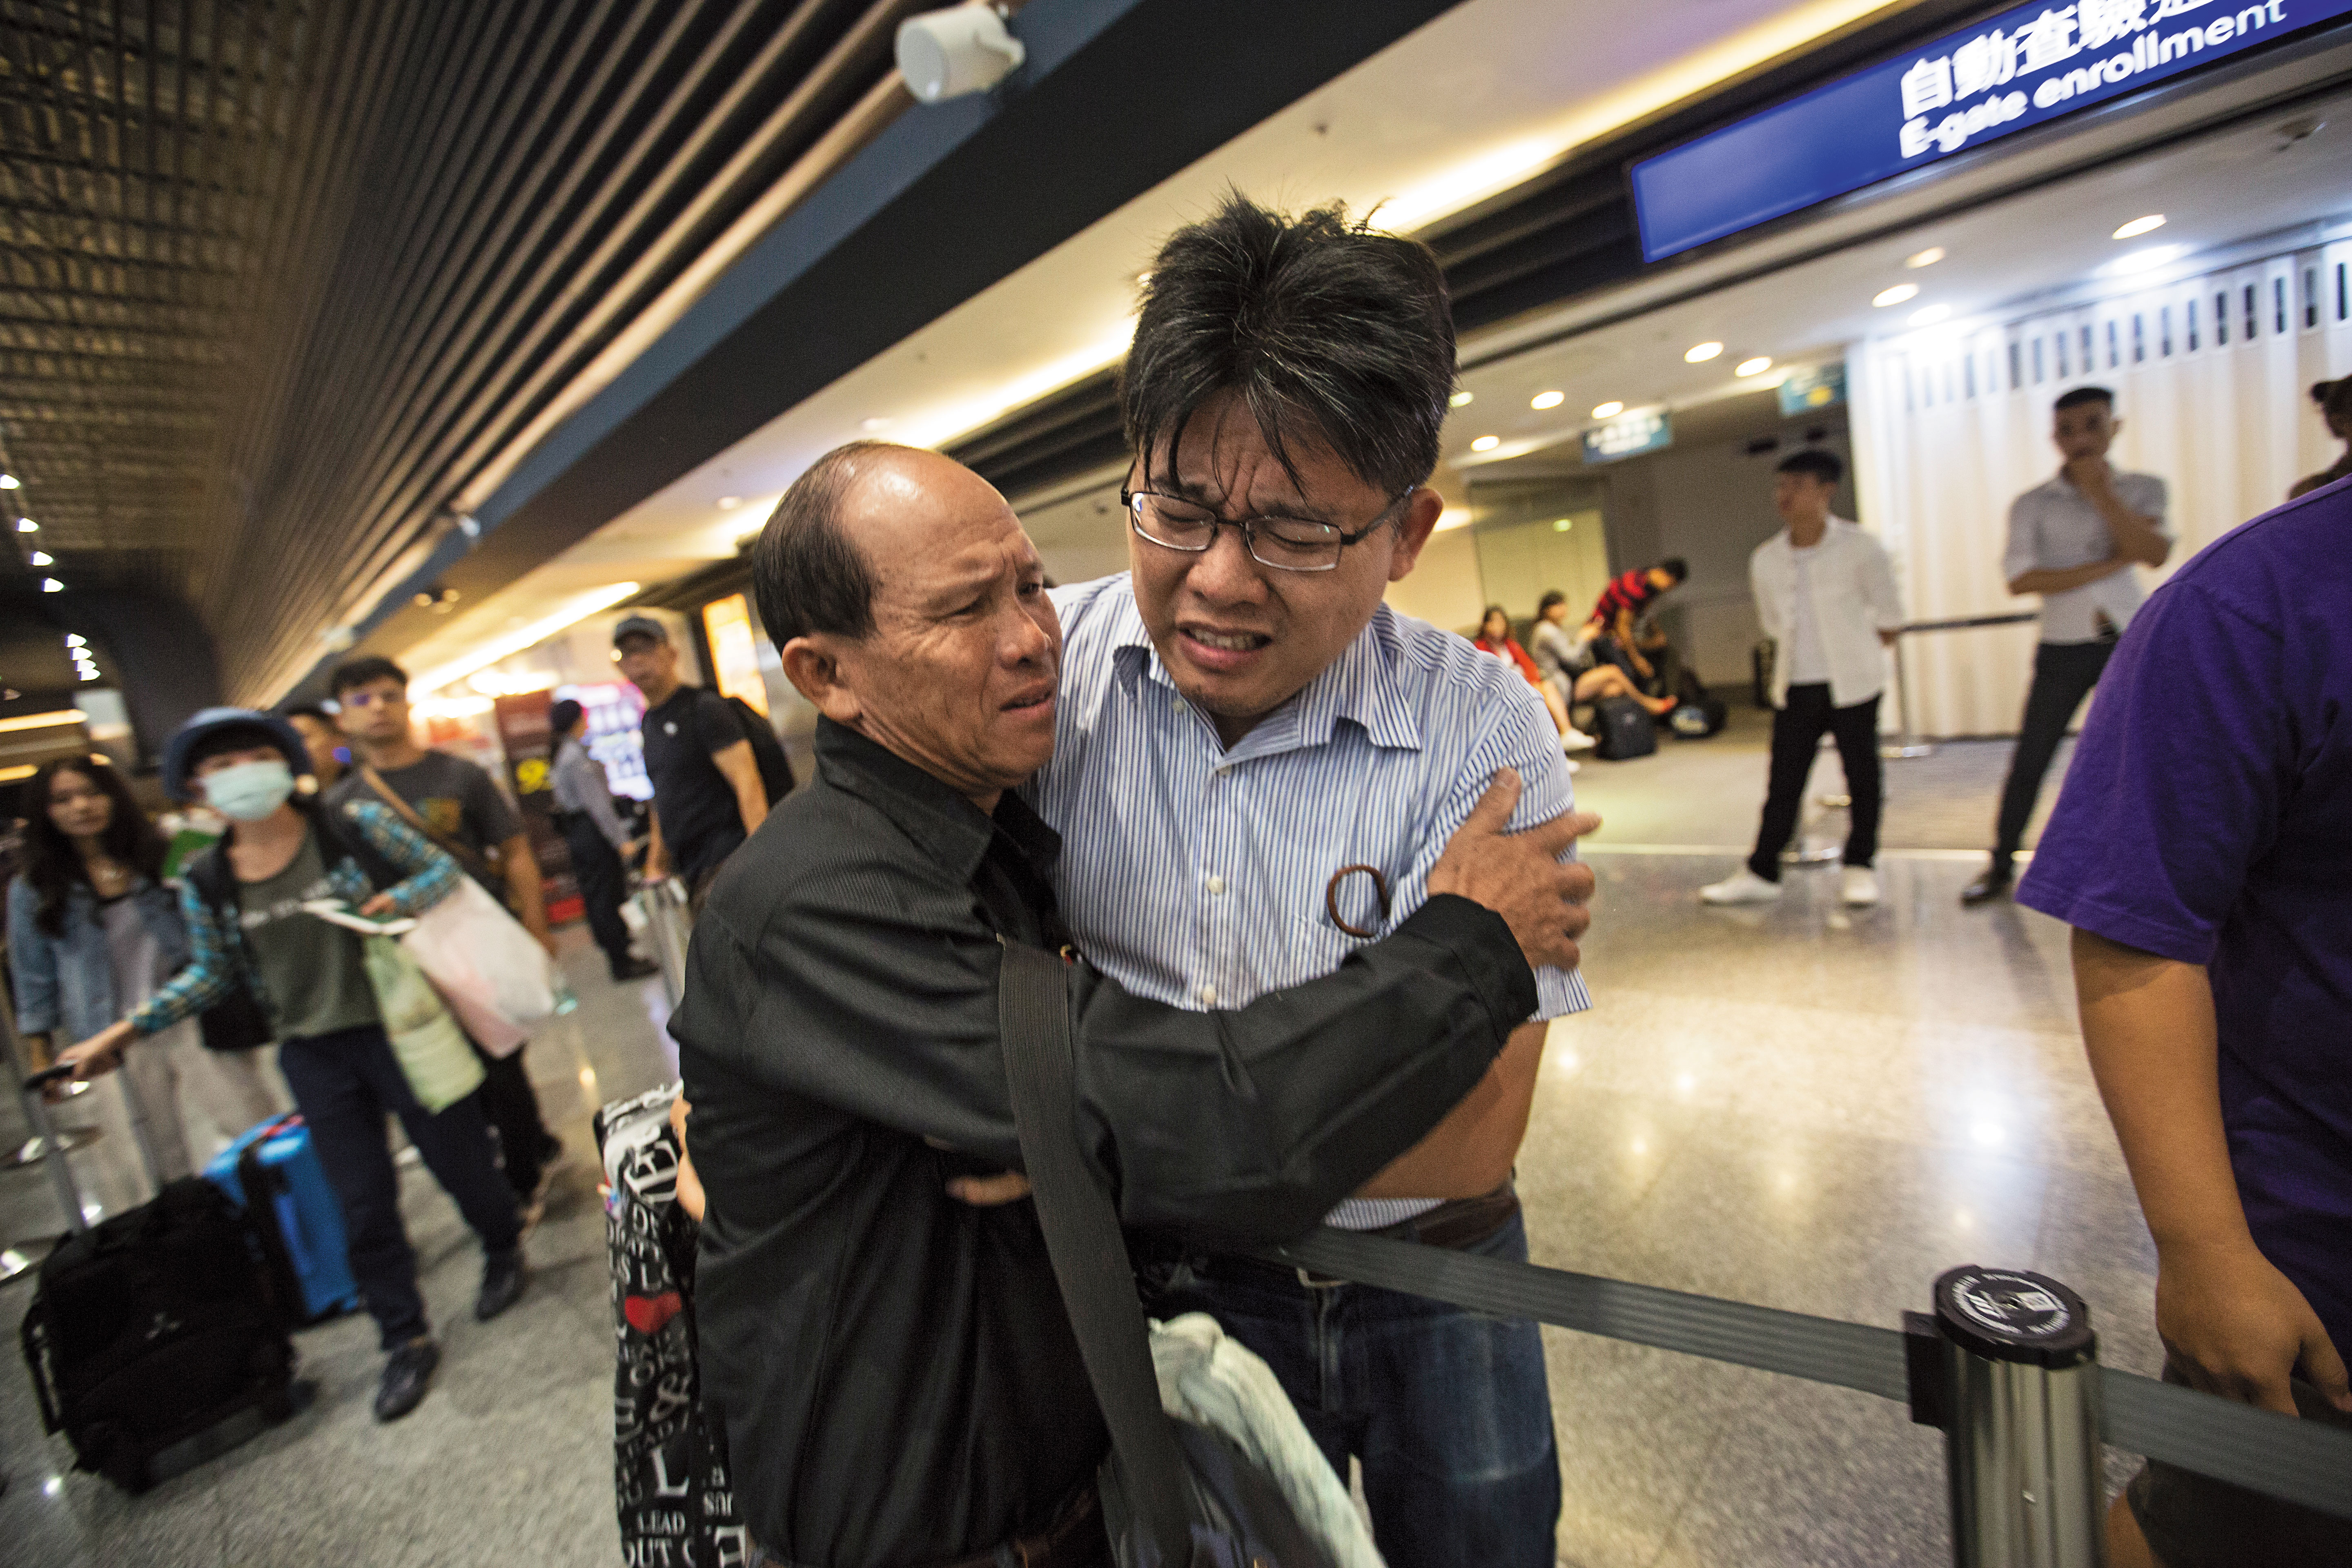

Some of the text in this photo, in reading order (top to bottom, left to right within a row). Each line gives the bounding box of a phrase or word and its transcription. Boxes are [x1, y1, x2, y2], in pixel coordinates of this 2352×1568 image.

[1899, 0, 2287, 159] E-gate enrollment
[1901, 0, 2215, 121] 自動查驗
